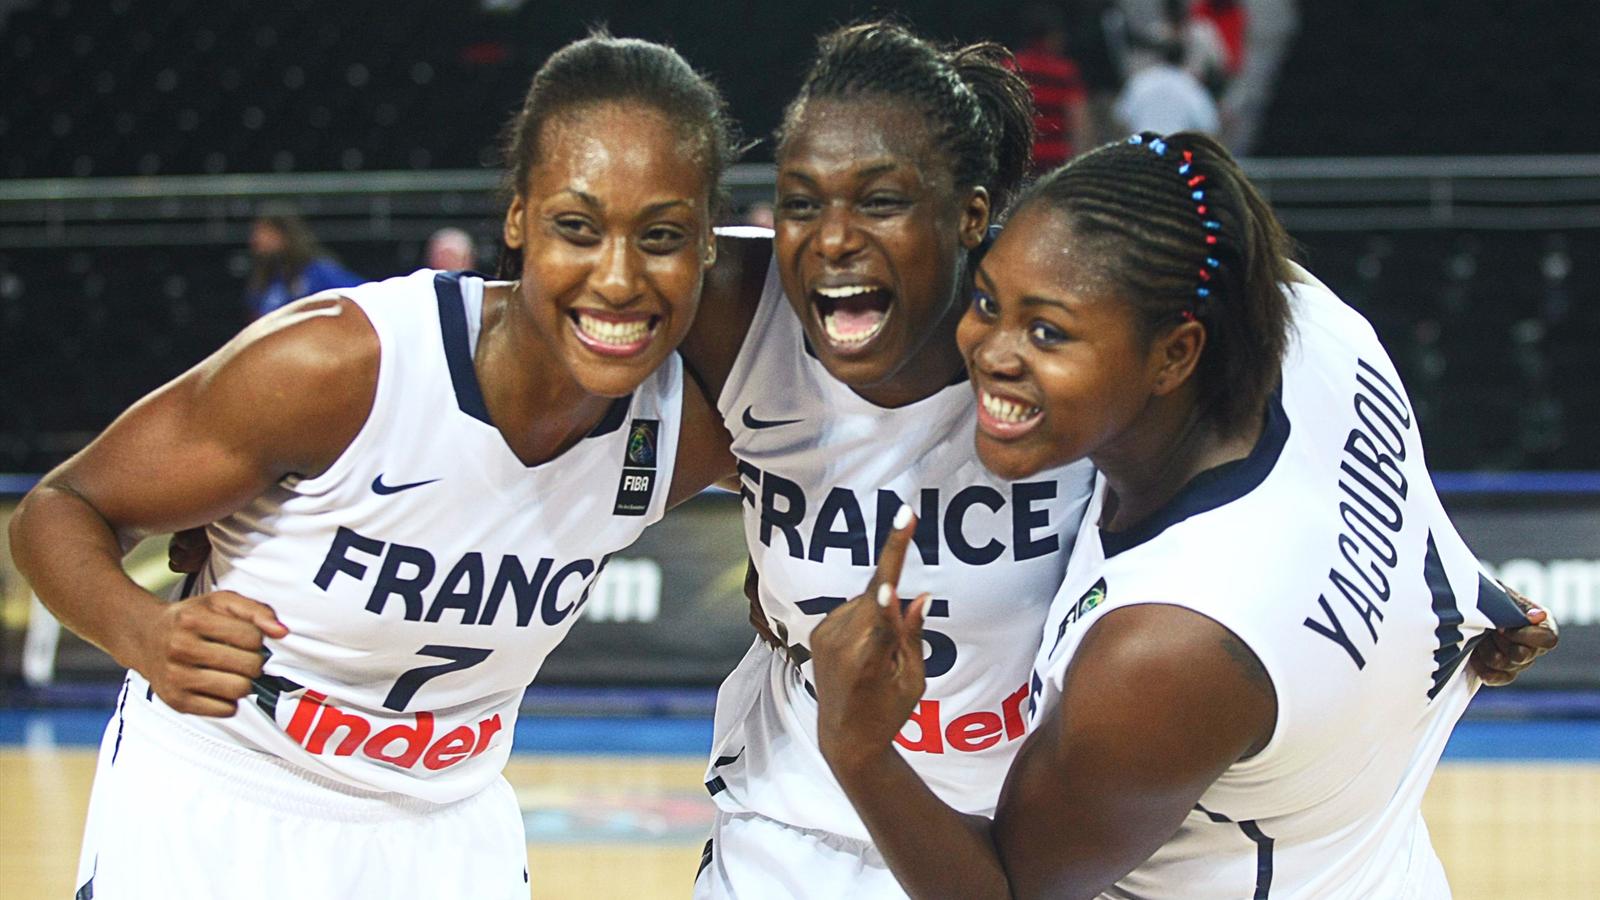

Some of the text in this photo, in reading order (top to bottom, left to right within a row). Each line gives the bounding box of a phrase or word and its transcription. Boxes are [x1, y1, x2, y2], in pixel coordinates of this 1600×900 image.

[623, 475, 650, 492] FIBA
[1303, 357, 1411, 671] YACOUBOU
[313, 525, 612, 626] FRANC
[382, 644, 495, 712] 7
